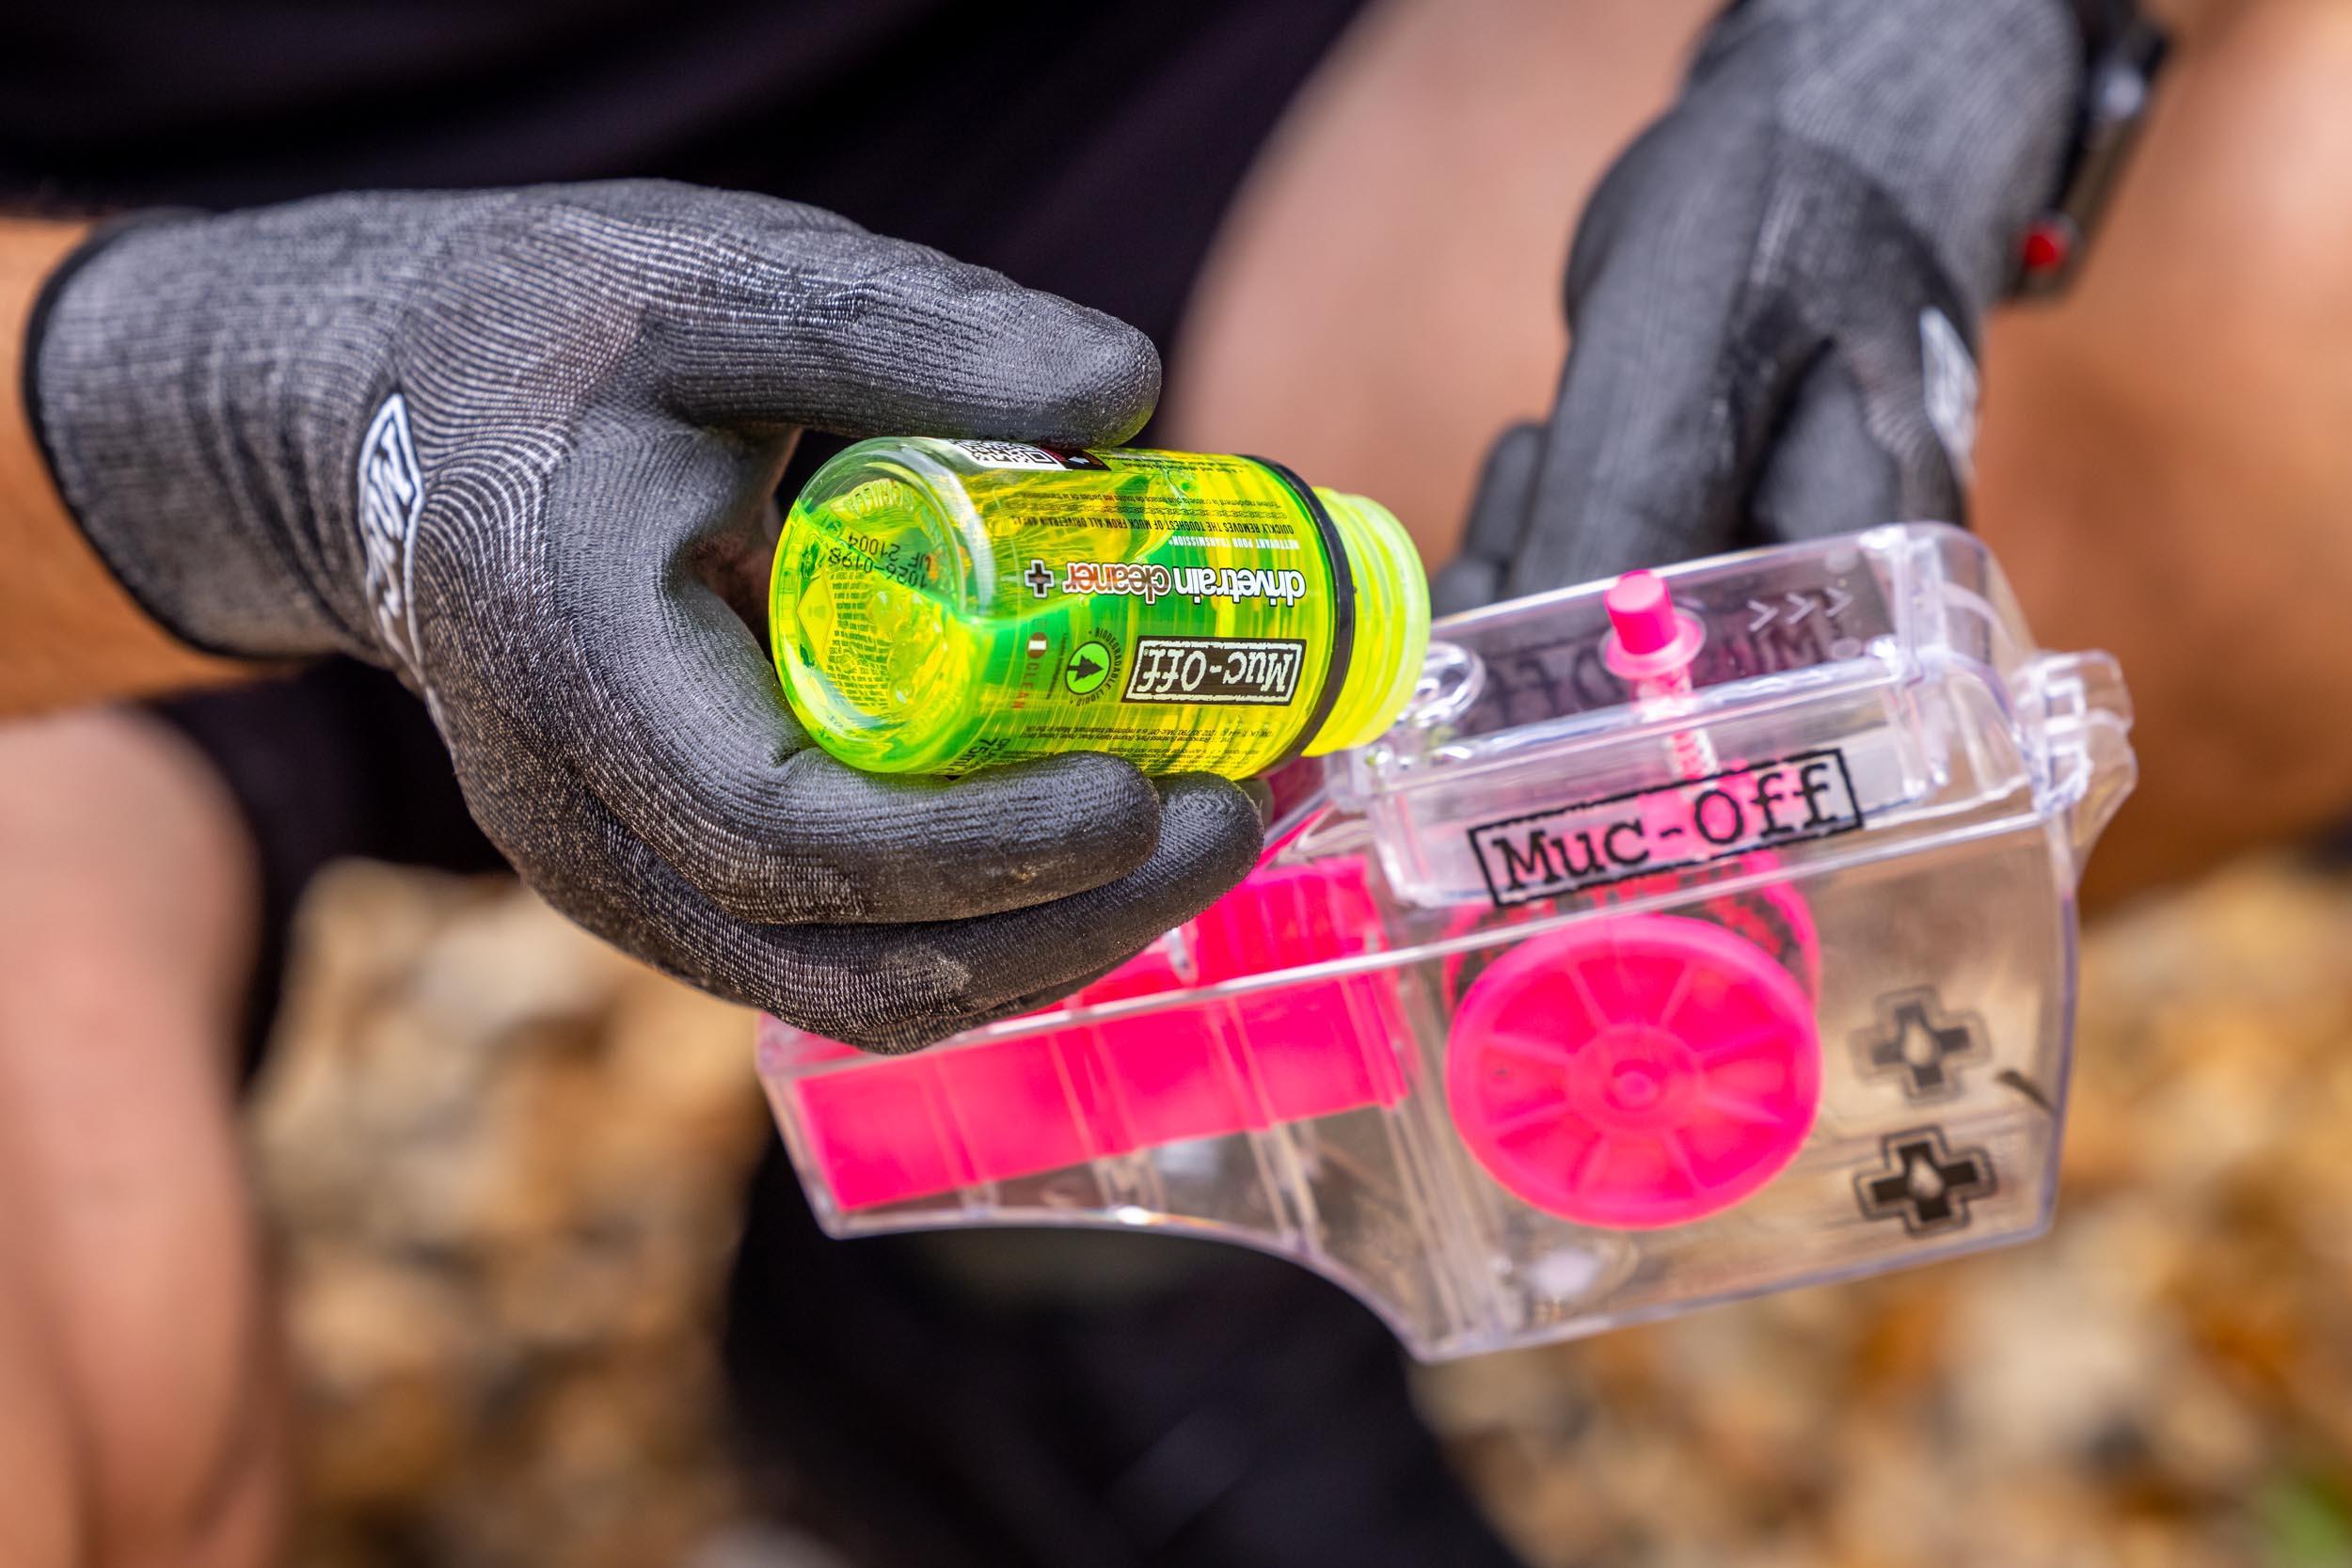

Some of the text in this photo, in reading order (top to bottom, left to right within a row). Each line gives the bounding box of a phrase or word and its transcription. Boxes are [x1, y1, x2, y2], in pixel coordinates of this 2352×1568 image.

[1088, 517, 1103, 529] ALL
[1104, 518, 1127, 529] FROM
[1128, 519, 1152, 530] MUCK
[1153, 520, 1163, 531] OF
[1164, 520, 1205, 531] TOUGHEST
[1206, 521, 1222, 532] THE
[1223, 522, 1261, 533] REMOVES
[1262, 524, 1294, 534] QUICKLY
[849, 532, 900, 561] 21004
[1063, 562, 1306, 608] drivetrain cleaner
[1076, 627, 1121, 706] BIODEGRADABLE LIQUID
[1492, 763, 1836, 889] Muc-Off
